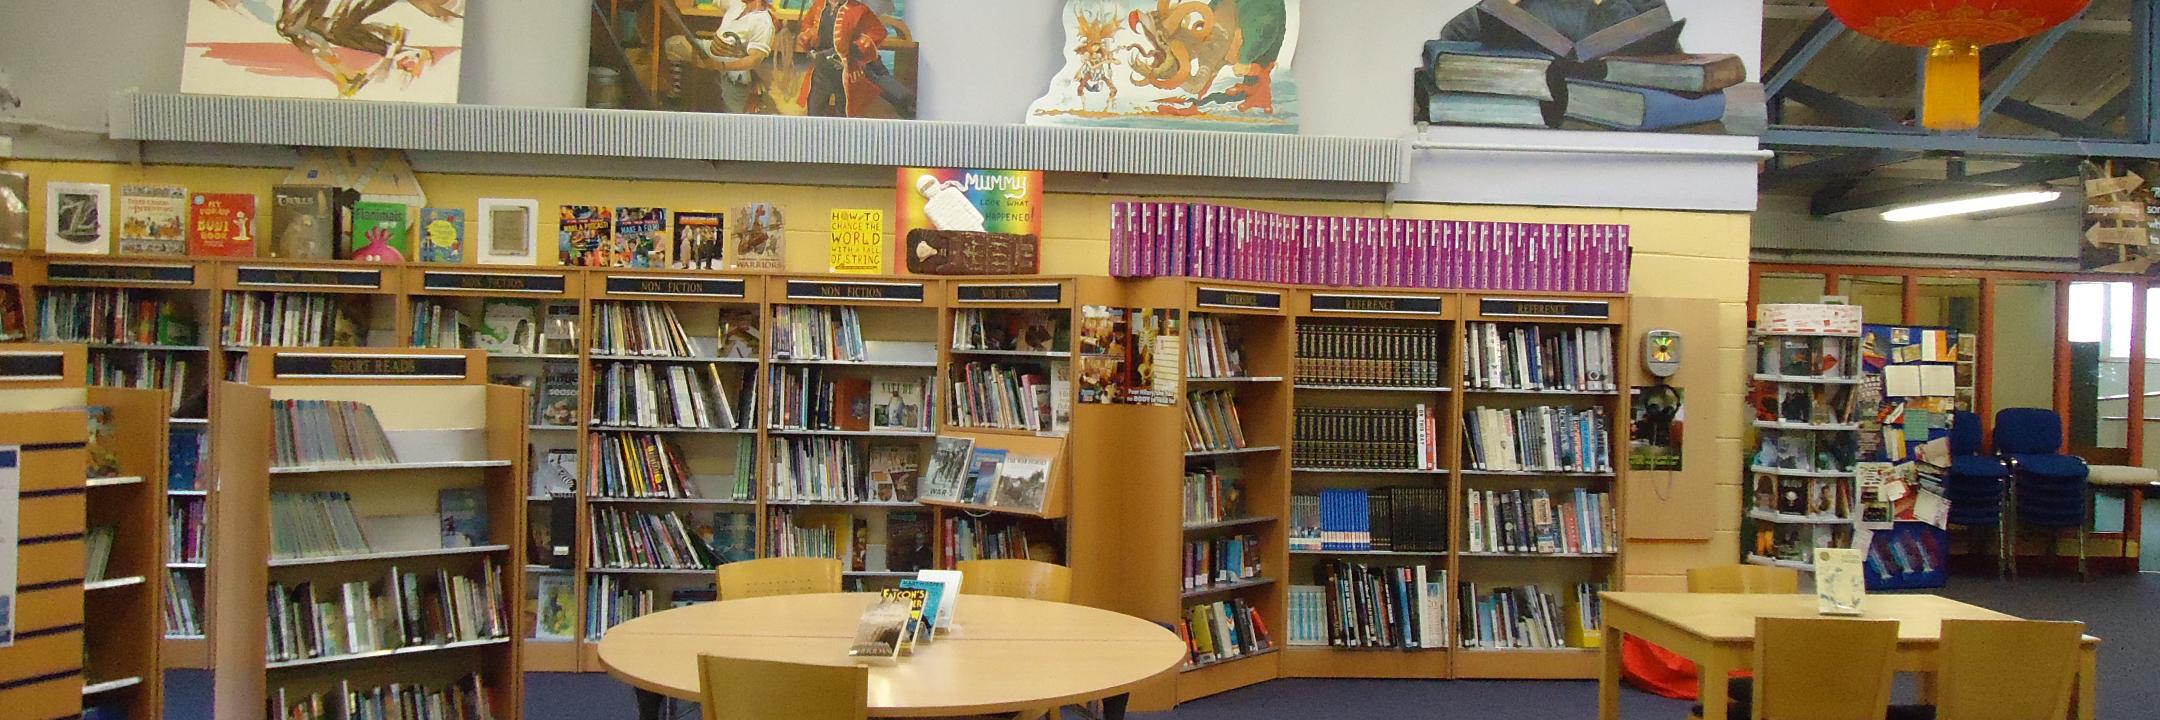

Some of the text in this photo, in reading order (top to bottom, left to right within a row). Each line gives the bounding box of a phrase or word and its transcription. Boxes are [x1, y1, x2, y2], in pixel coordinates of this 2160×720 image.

[964, 172, 1027, 200] MUMMY
[863, 212, 880, 221] TO
[831, 222, 880, 231] CHANGE THE
[831, 231, 881, 245] WORLD
[736, 260, 785, 269] WARRIORS
[831, 254, 880, 265] OF STRING
[641, 281, 703, 293] NON FICTION
[821, 286, 882, 297] NON FICTION
[1345, 298, 1395, 310] REFERENCE
[1517, 302, 1566, 314] REFERENCE
[331, 359, 416, 373] SHORT READS
